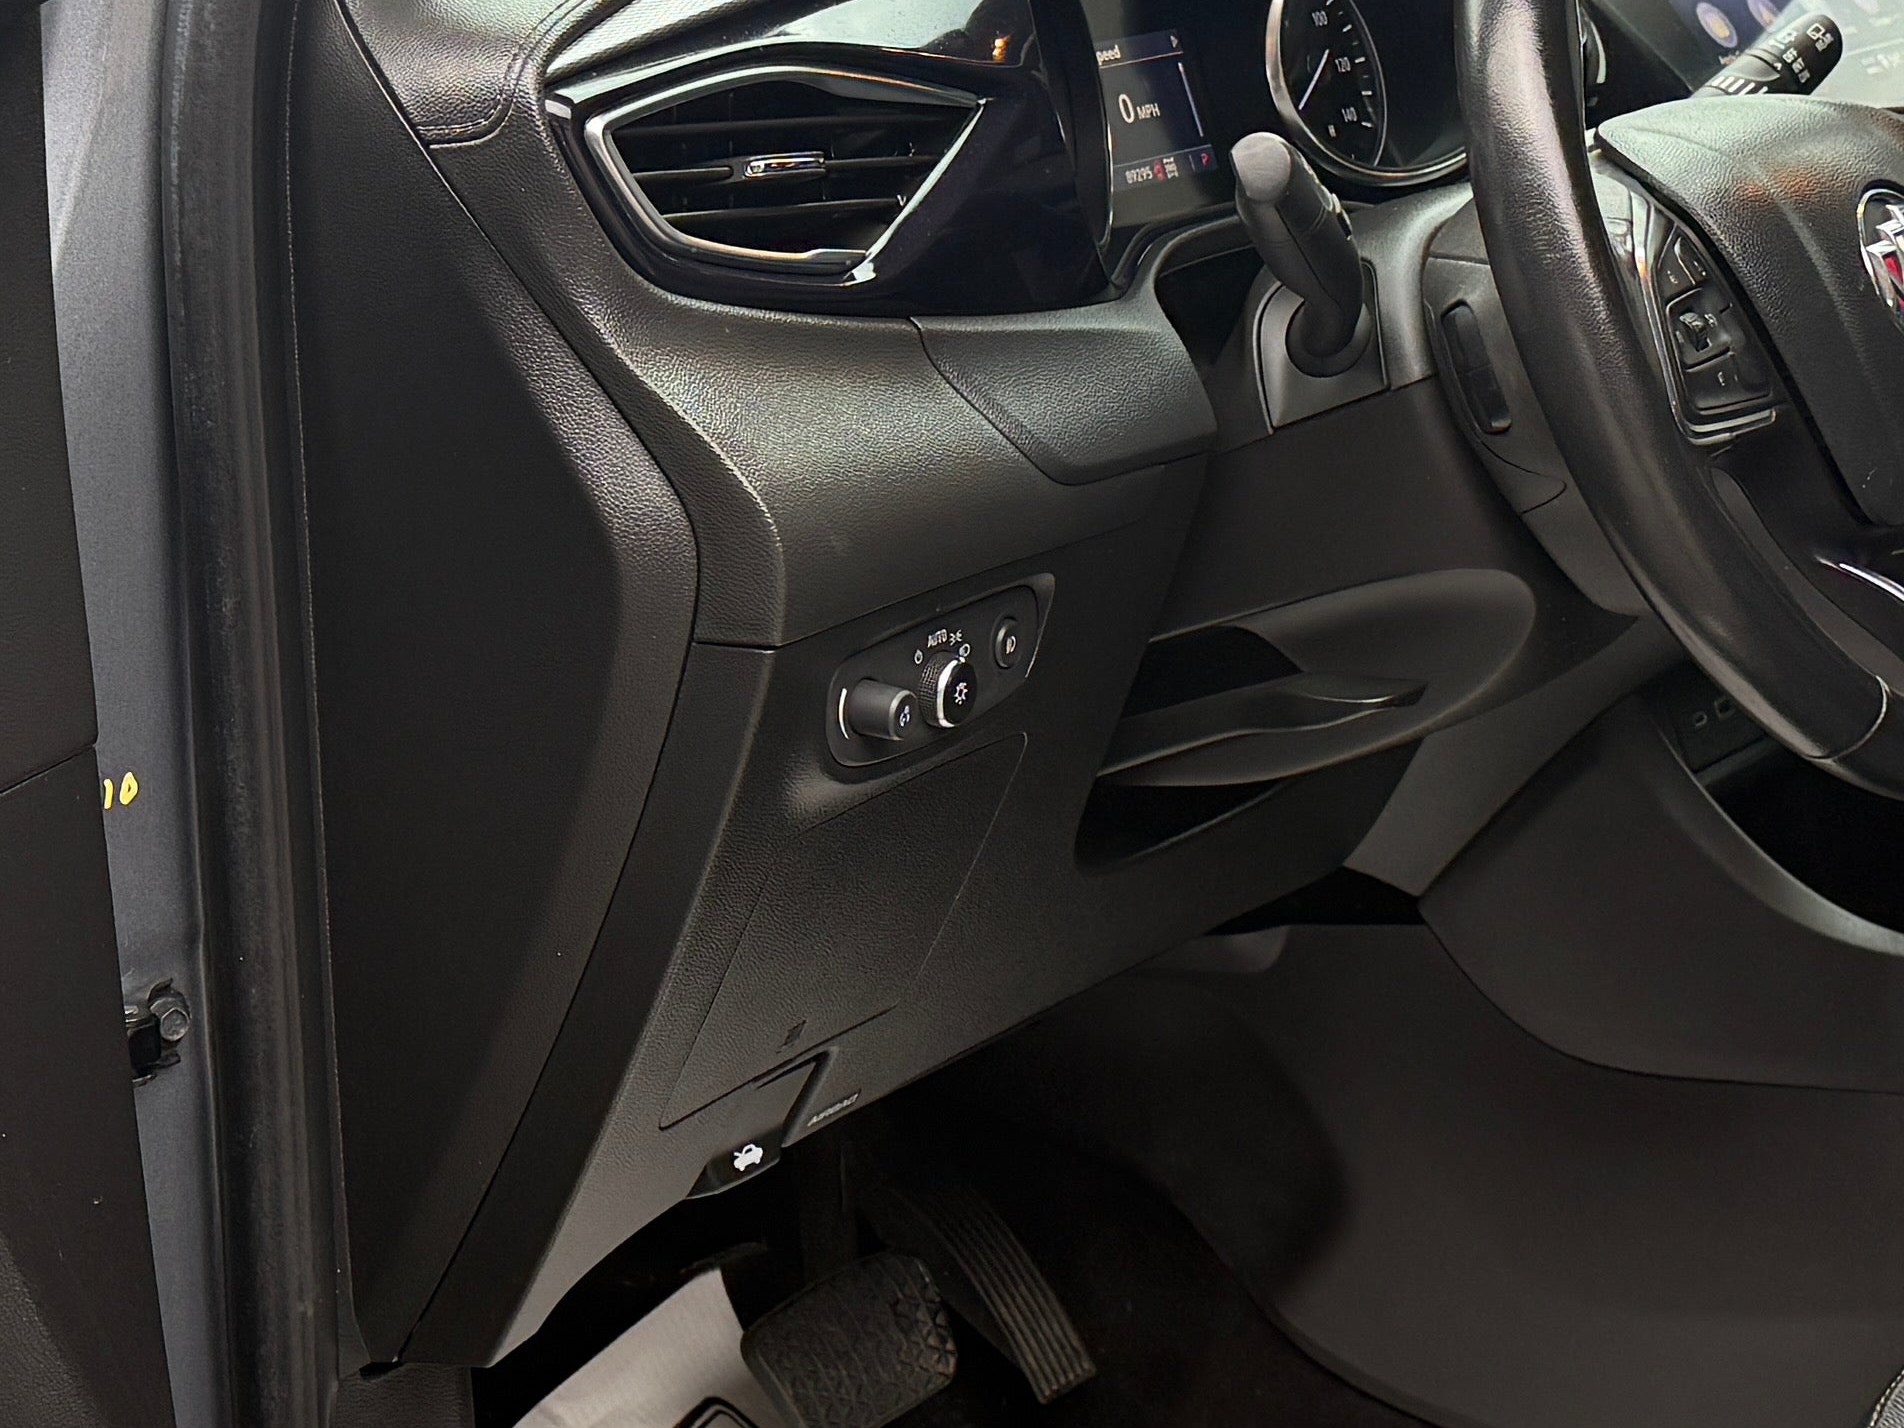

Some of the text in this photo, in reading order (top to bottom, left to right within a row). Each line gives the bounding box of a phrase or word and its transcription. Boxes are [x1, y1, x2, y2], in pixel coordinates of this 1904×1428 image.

[1311, 10, 1328, 27] 100
[1096, 44, 1121, 65] peed
[1334, 57, 1351, 72] 120
[1118, 93, 1161, 124] 0 MPH
[1341, 106, 1357, 123] 140
[927, 628, 947, 648] AUTO
